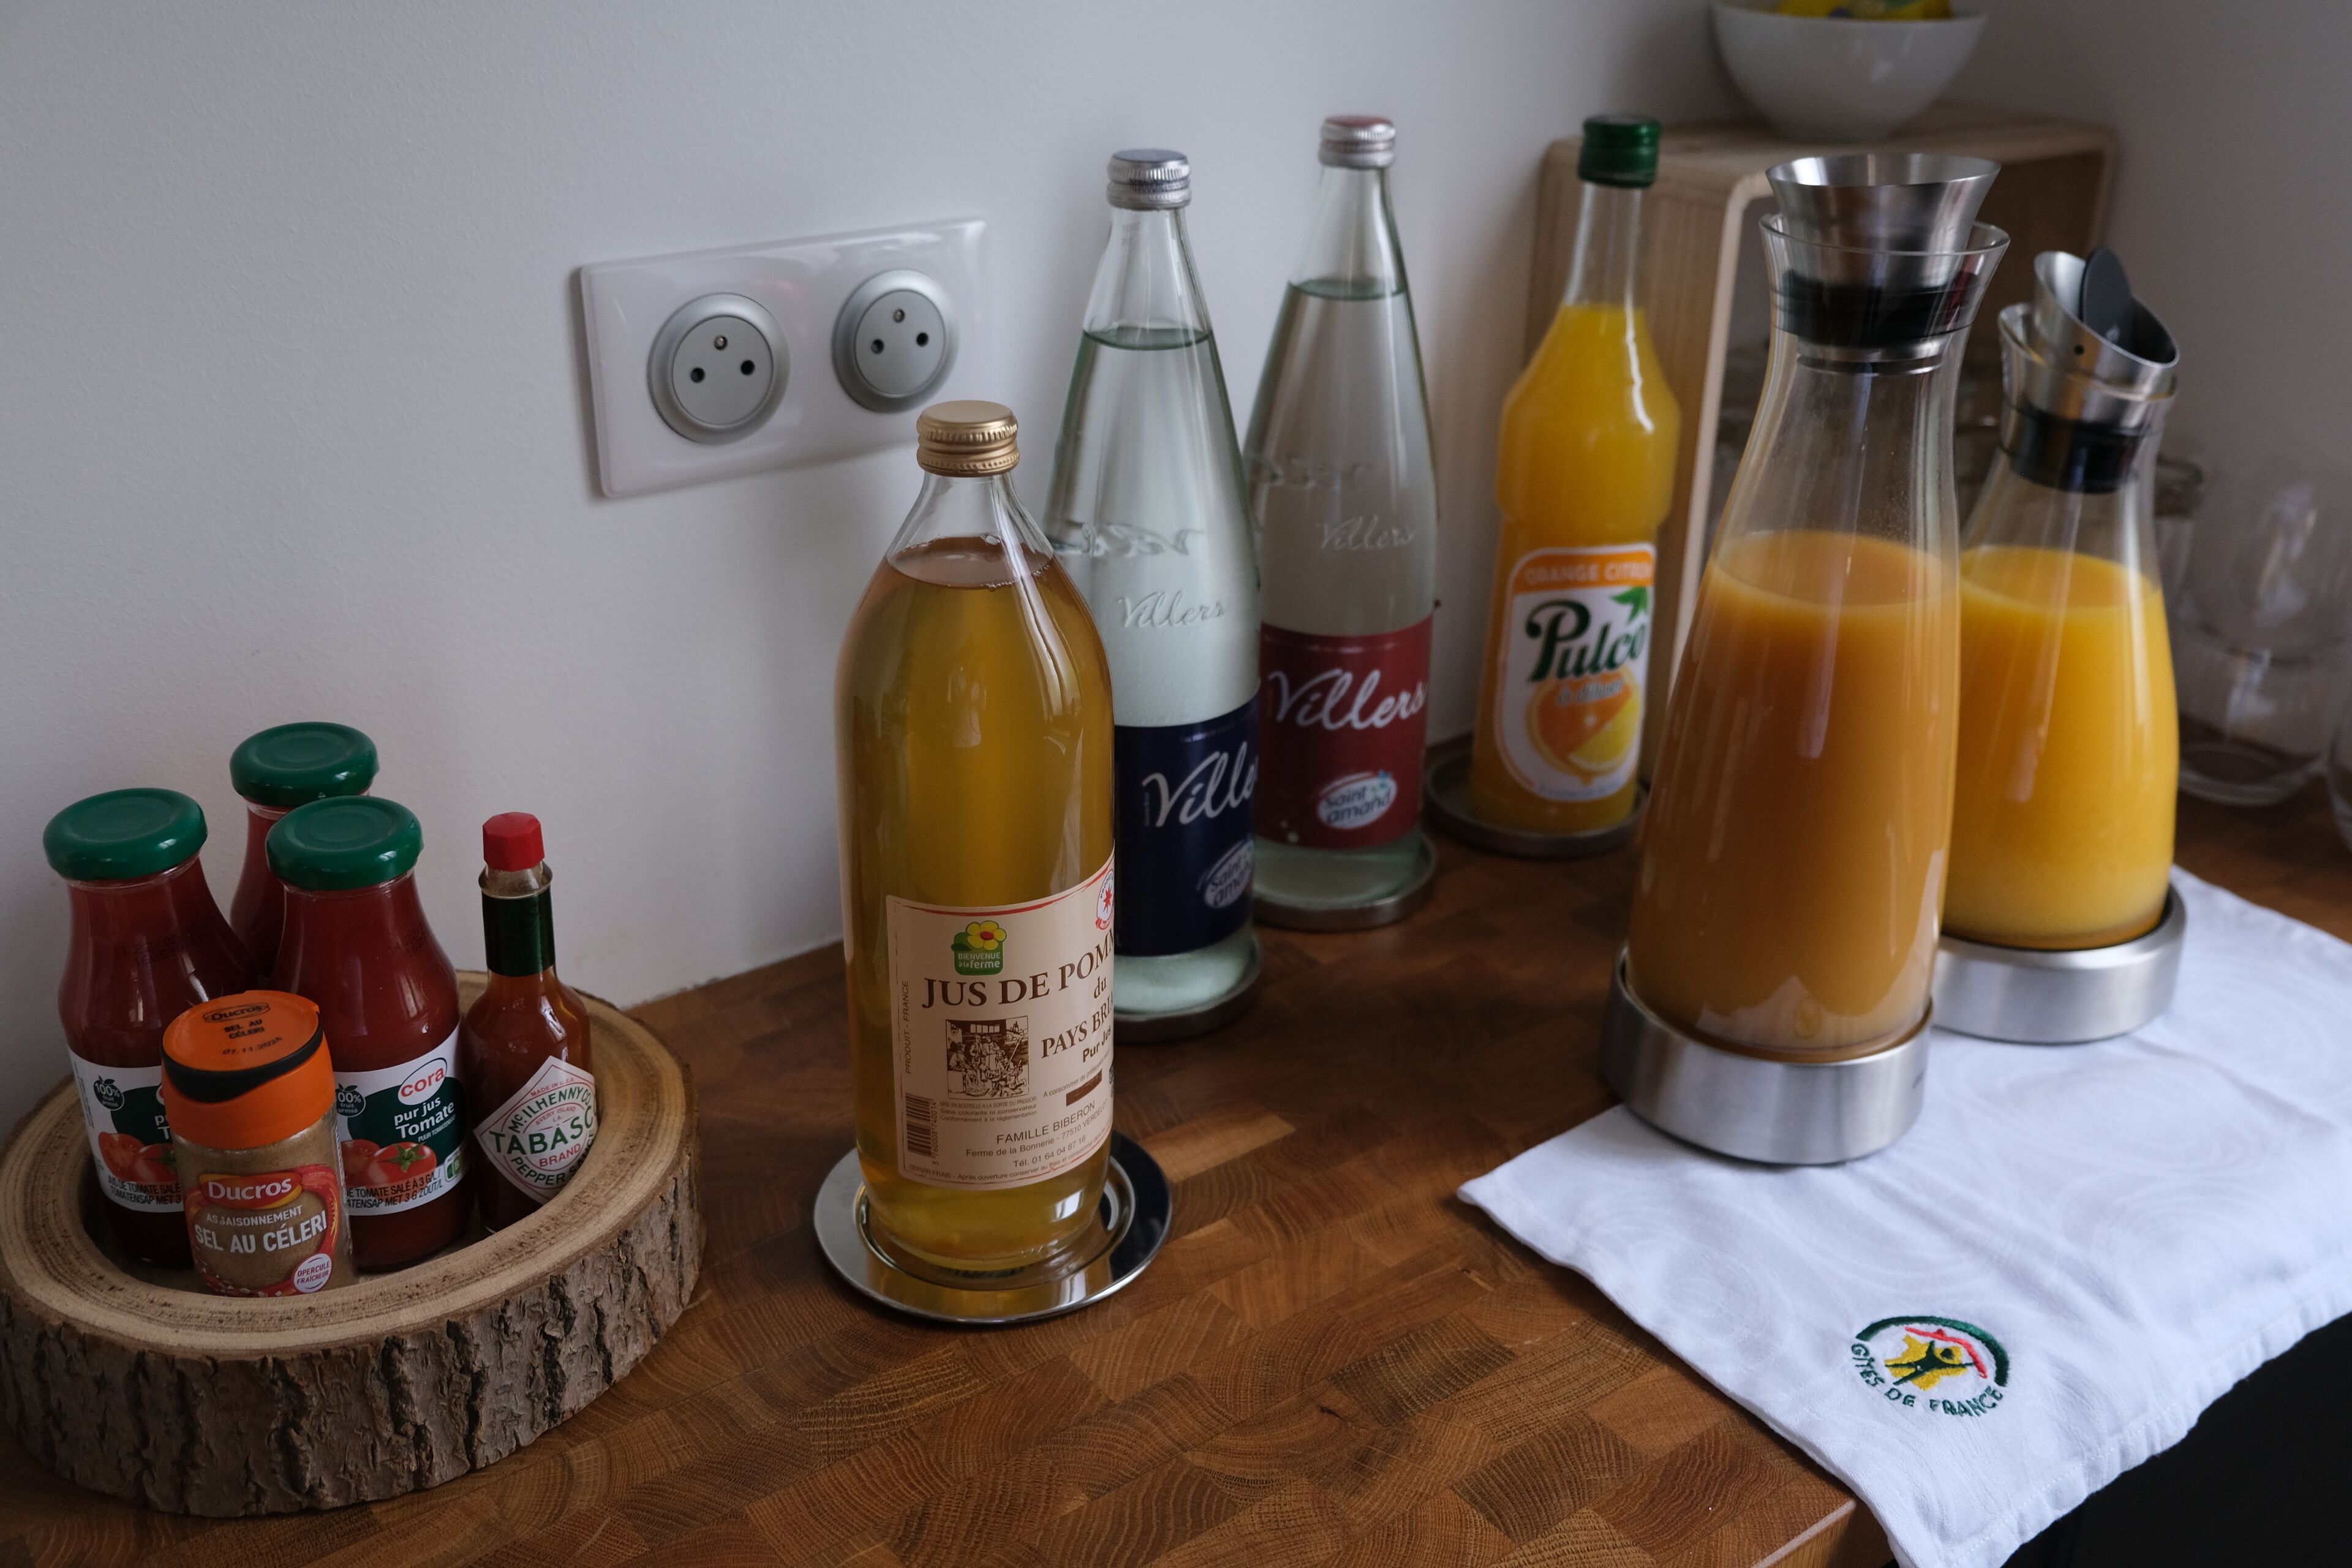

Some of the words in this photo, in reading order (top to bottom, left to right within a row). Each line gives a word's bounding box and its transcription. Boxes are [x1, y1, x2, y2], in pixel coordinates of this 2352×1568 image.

[1316, 514, 1415, 550] Villers
[1523, 562, 1600, 586] ORANGE
[1117, 590, 1224, 627] Villers
[1525, 599, 1646, 683] Pulco
[1267, 666, 1427, 731] Villers
[1142, 740, 1259, 829] Ville
[958, 952, 1001, 960] BIENVENUE
[970, 960, 1000, 969] ferme
[922, 978, 987, 1008] JUS
[998, 972, 1050, 1005] DE
[1093, 975, 1107, 999] du
[211, 1005, 263, 1021] Ducros
[249, 1019, 263, 1027] AU
[1041, 1020, 1087, 1059] PAYS
[1083, 1044, 1100, 1063] Pur
[1101, 1025, 1112, 1046] Jus
[95, 1083, 121, 1098] 100%
[400, 1068, 444, 1098] cora
[530, 1085, 550, 1097] MADE
[1049, 1079, 1079, 1096] consommer
[1080, 1074, 1086, 1082] de
[338, 1092, 361, 1103] 00%
[998, 1104, 1037, 1114] conservateur
[394, 1108, 419, 1126] pur
[422, 1096, 442, 1116] jus
[396, 1102, 454, 1139] Tomate
[535, 1111, 554, 1126] AVERY
[997, 1110, 1037, 1122] réglementation
[997, 1125, 1049, 1144] FAMILLE
[1053, 1100, 1095, 1131] BIBERON
[997, 1147, 1006, 1155] de
[1020, 1137, 1054, 1153] Bonnerie
[1062, 1125, 1081, 1139] 77510
[1014, 1159, 1029, 1167] Tél.
[1045, 1152, 1054, 1160] 64
[1057, 1146, 1066, 1155] 04
[1068, 1142, 1076, 1151] 87
[1078, 1135, 1086, 1144] 16
[540, 1143, 581, 1168] BRAND
[511, 1156, 566, 1186] PEPPER
[910, 1164, 931, 1175] SERVIR
[1010, 1166, 1039, 1177] conserver
[110, 1185, 154, 1205] TOMATENSAP
[156, 1194, 173, 1205] MET
[175, 1194, 181, 1204] 3
[119, 1180, 128, 1191] DE
[127, 1181, 159, 1194] TOMATE
[159, 1182, 181, 1194] SALÉ
[208, 1178, 292, 1200] Ducros
[356, 1186, 389, 1199] TOMATE
[391, 1180, 410, 1195] SALÉ
[412, 1177, 418, 1188] À
[419, 1177, 424, 1186] 3
[346, 1199, 383, 1209] ATENSAP
[385, 1194, 403, 1207] MET
[411, 1190, 417, 1200] G
[194, 1224, 224, 1251] SEL
[230, 1234, 256, 1254] AU
[263, 1210, 327, 1252] CÉLERI
[296, 1270, 329, 1284] FRAÎCHEUR
[297, 1261, 330, 1276] OPERCULE
[1885, 1387, 1918, 1407] DE
[1929, 1385, 2004, 1417] FRANCE
